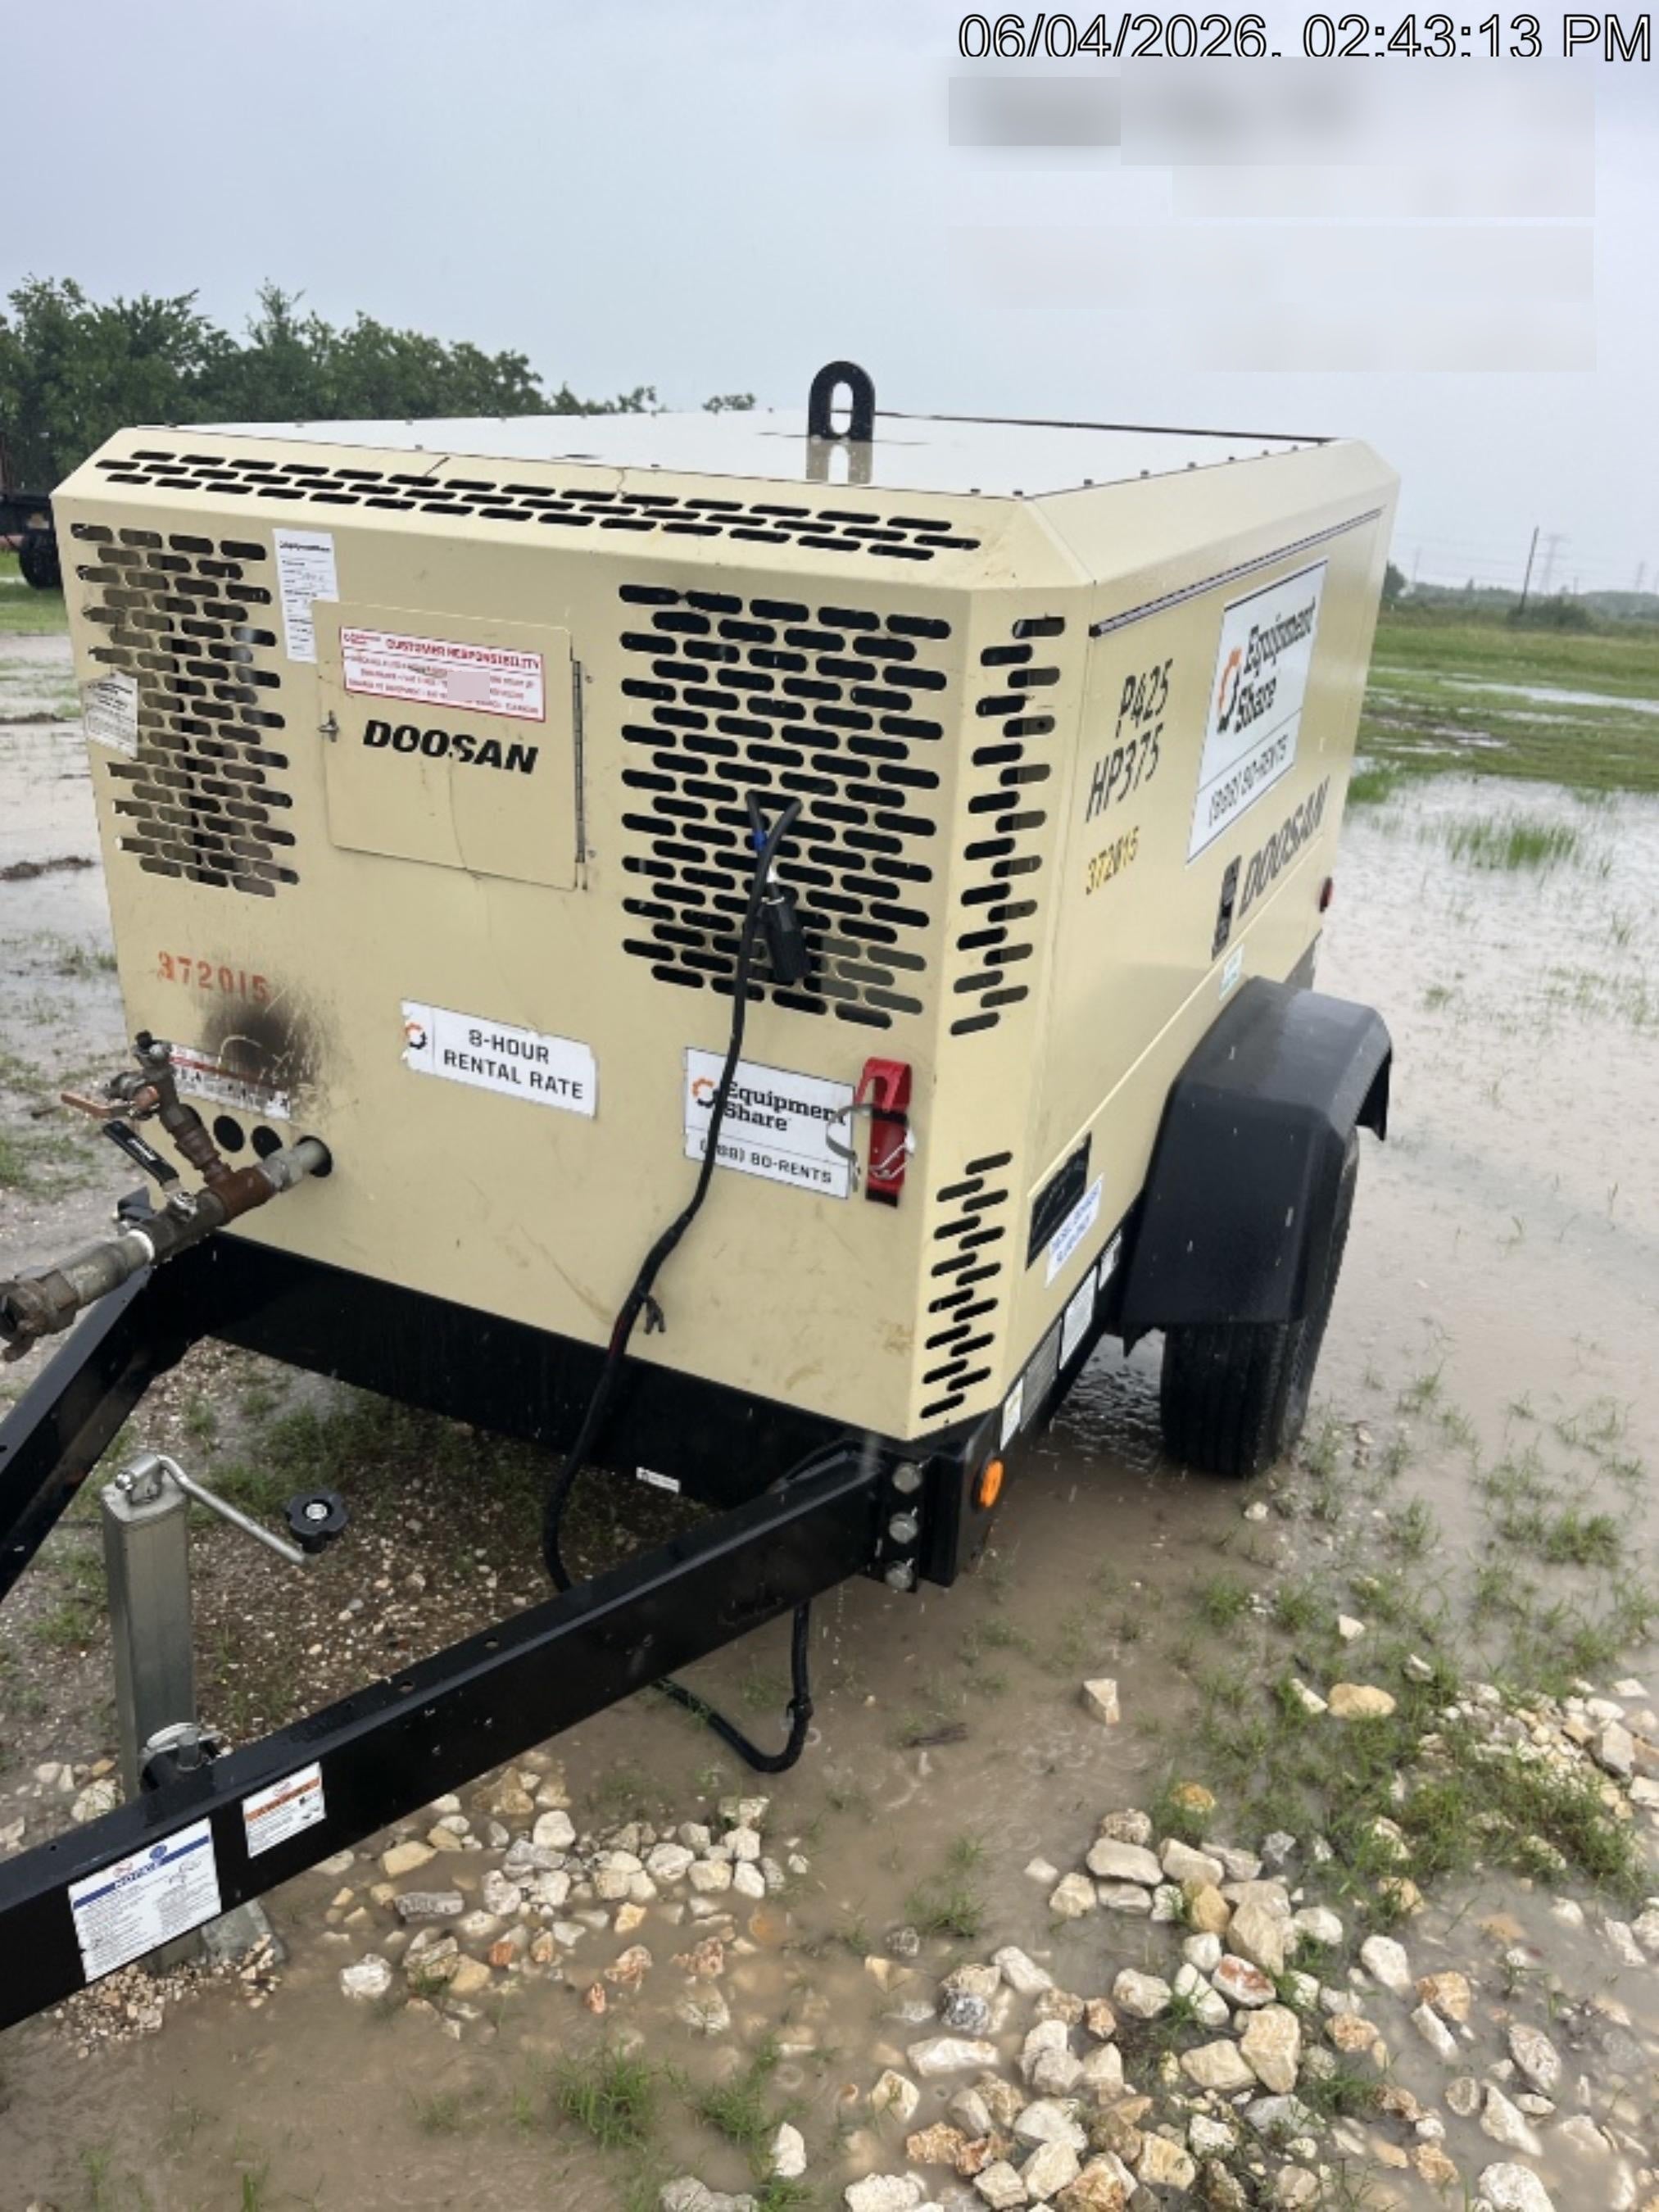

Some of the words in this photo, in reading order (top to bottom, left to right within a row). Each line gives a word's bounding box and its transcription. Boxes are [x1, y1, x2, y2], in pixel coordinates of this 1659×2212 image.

[1244, 596, 1316, 679] Equipment
[1114, 658, 1173, 739] P425
[1234, 678, 1276, 734] Share
[363, 719, 539, 774] DOOSAN
[1085, 722, 1163, 823] HP375
[1237, 774, 1330, 920] DOOSAN
[443, 1049, 522, 1085] RENTAL
[529, 1071, 583, 1099] RATE
[469, 1029, 550, 1064] 8-HOUR
[723, 1101, 787, 1131] Share
[700, 1137, 746, 1162] (88)
[751, 1152, 832, 1184] 80-RENTS
